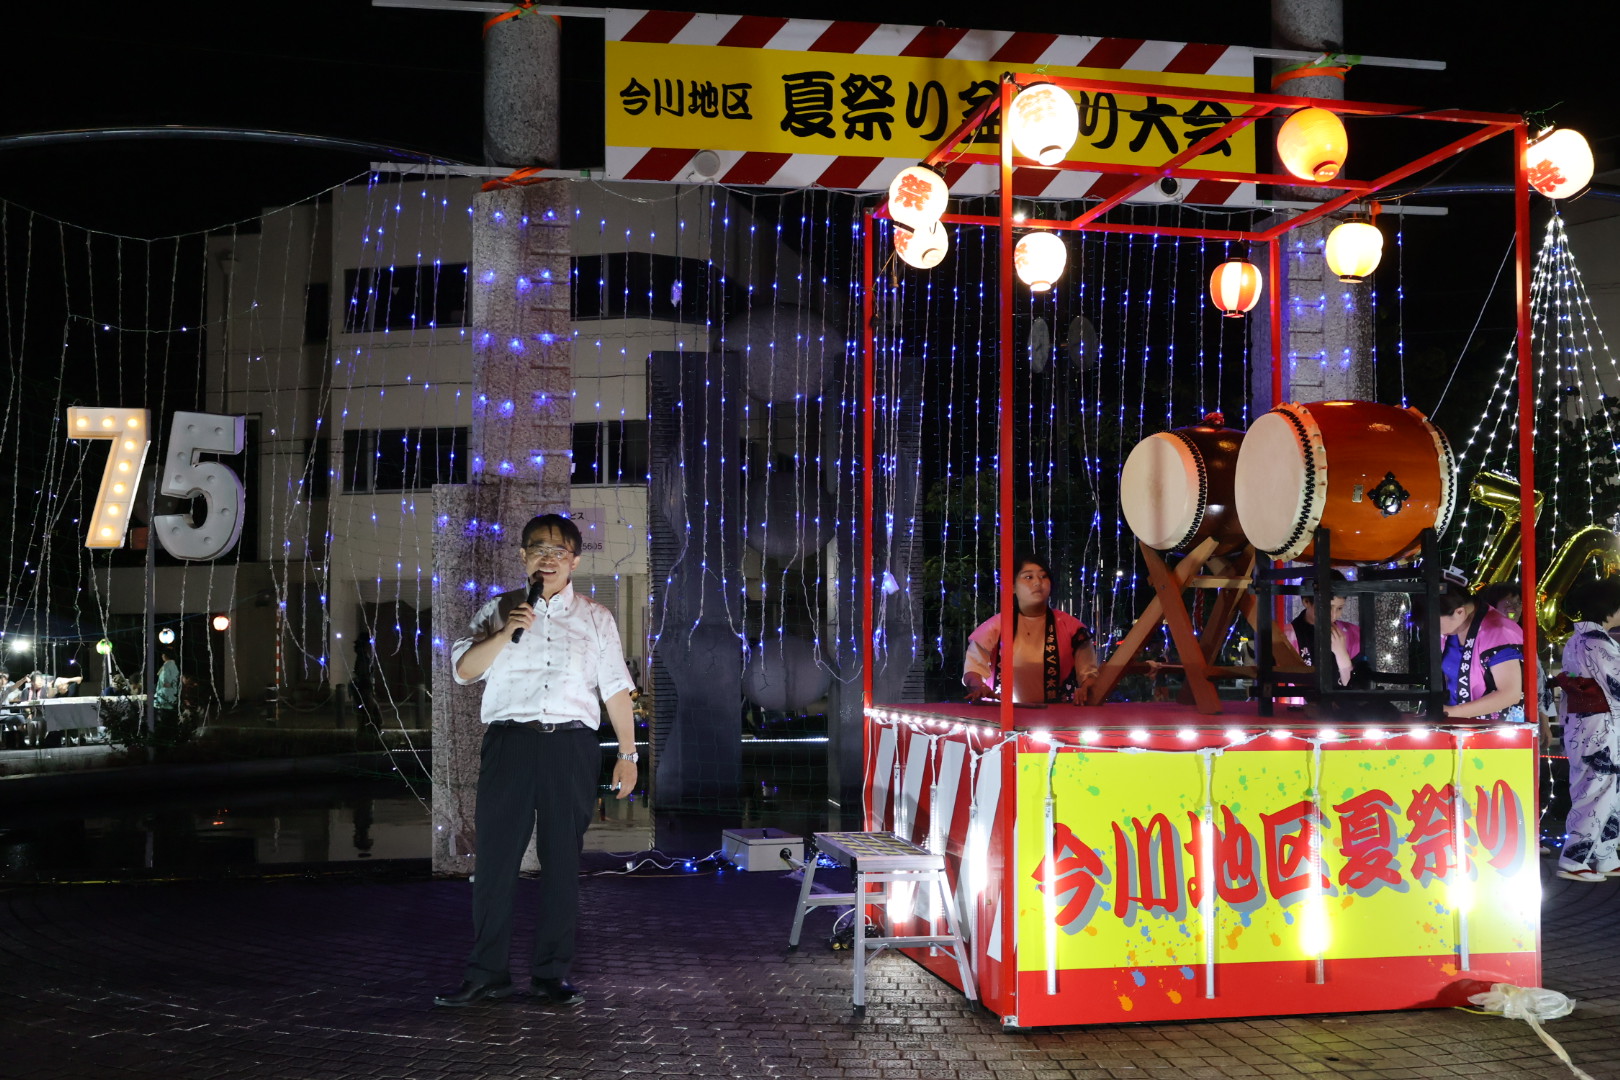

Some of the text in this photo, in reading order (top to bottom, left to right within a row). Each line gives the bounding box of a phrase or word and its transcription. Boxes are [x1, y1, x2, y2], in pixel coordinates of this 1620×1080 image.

[619, 69, 1234, 157] 今川地区 夏祭り盆り大会
[894, 173, 932, 211] 祭
[1031, 778, 1527, 933] 今川地区夏祭り
